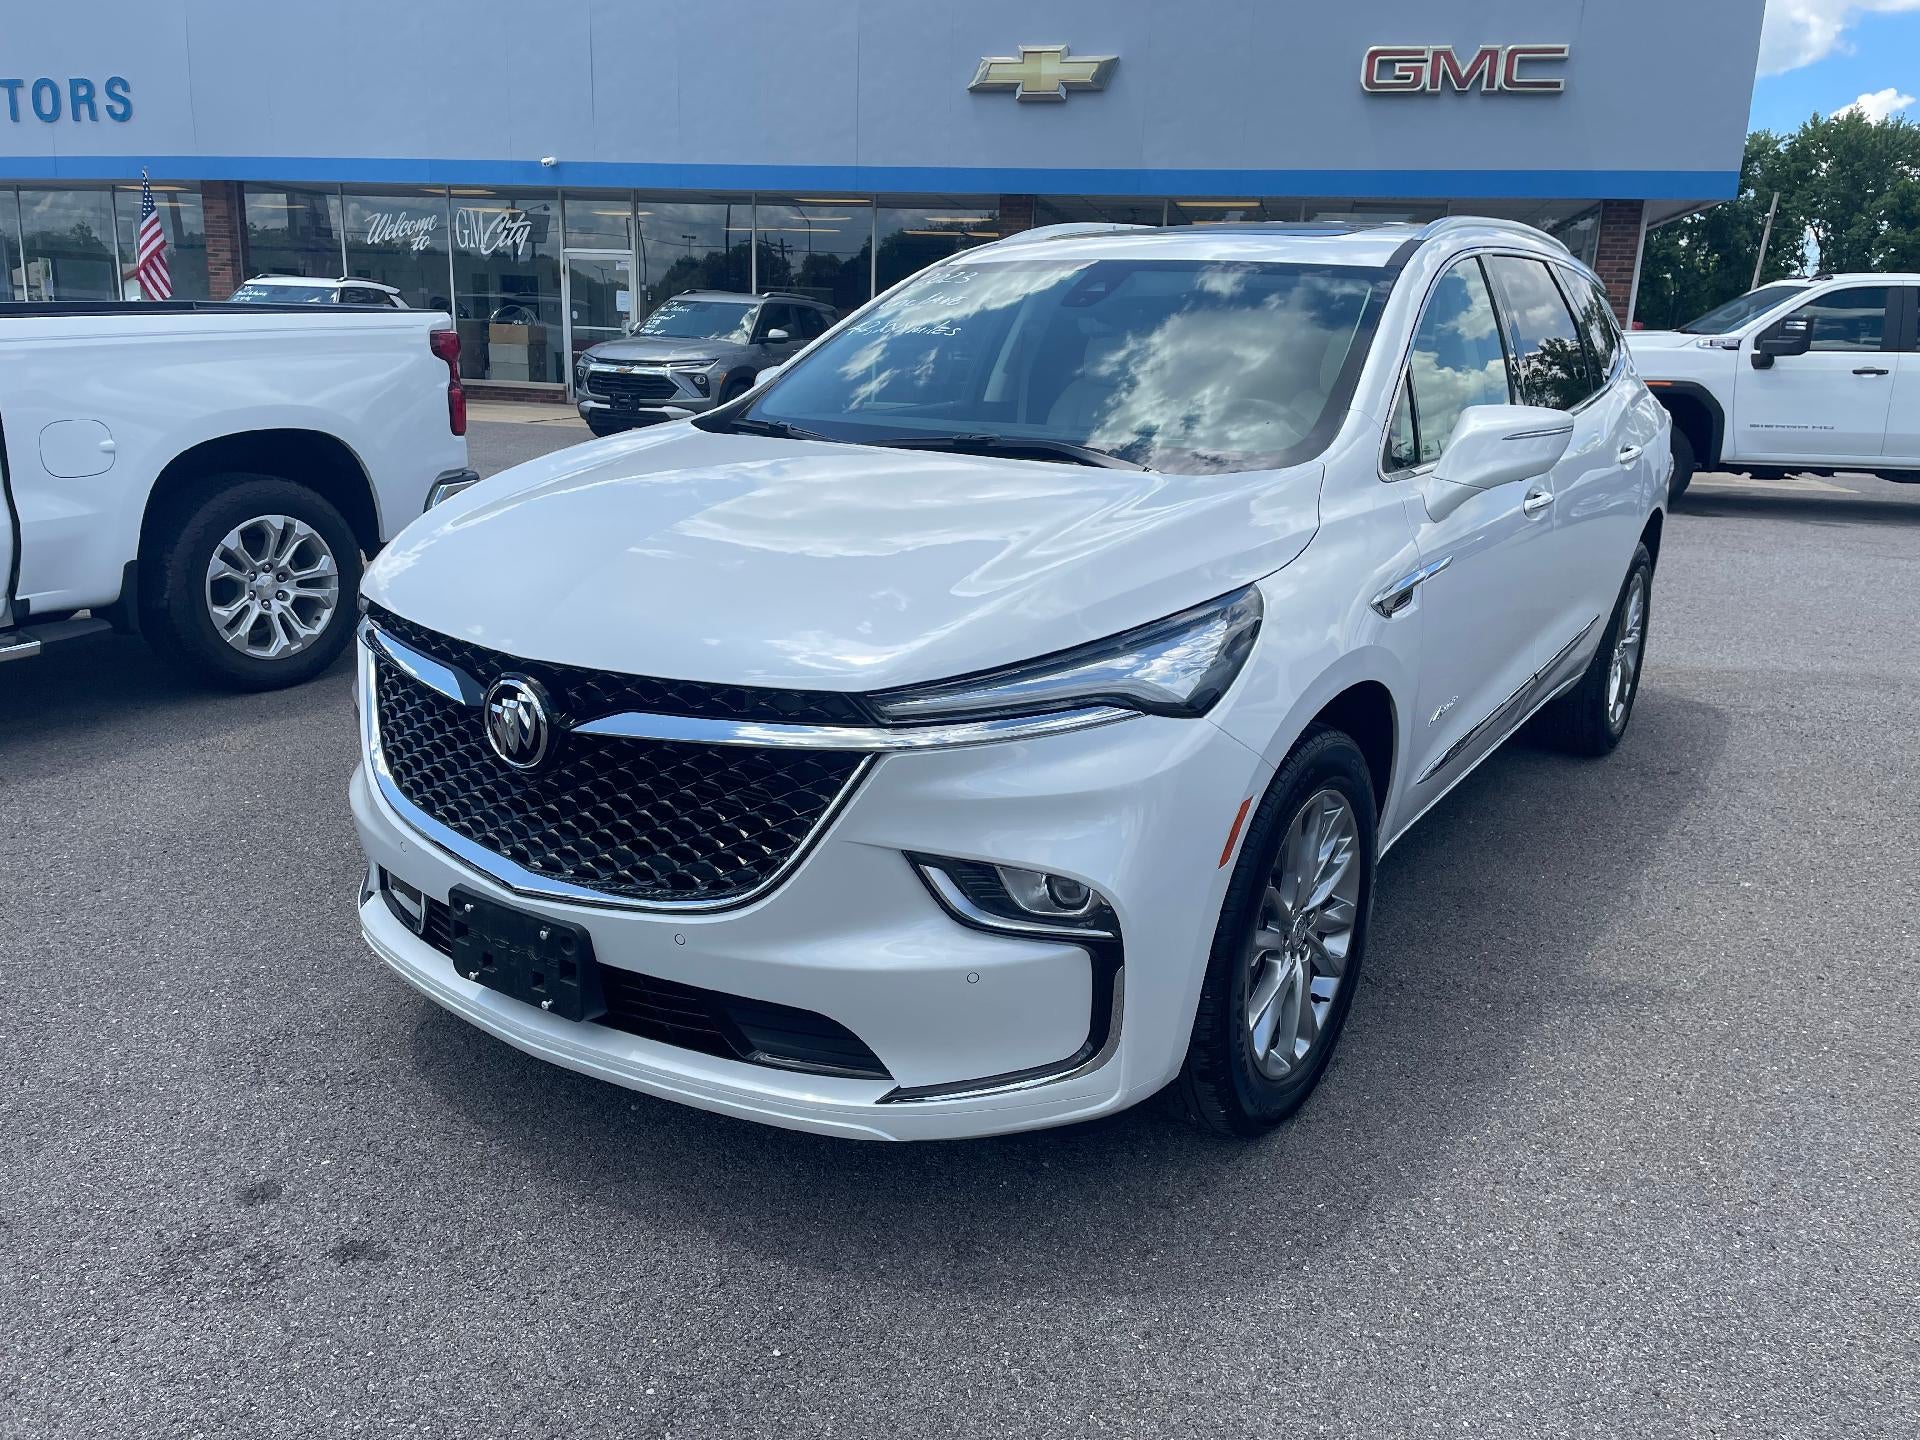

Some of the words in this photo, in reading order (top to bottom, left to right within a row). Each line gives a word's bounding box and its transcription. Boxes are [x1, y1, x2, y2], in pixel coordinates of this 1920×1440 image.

[1360, 44, 1569, 95] GMC
[0, 76, 133, 123] TORS
[364, 211, 438, 245] Welcome
[410, 231, 431, 251] to
